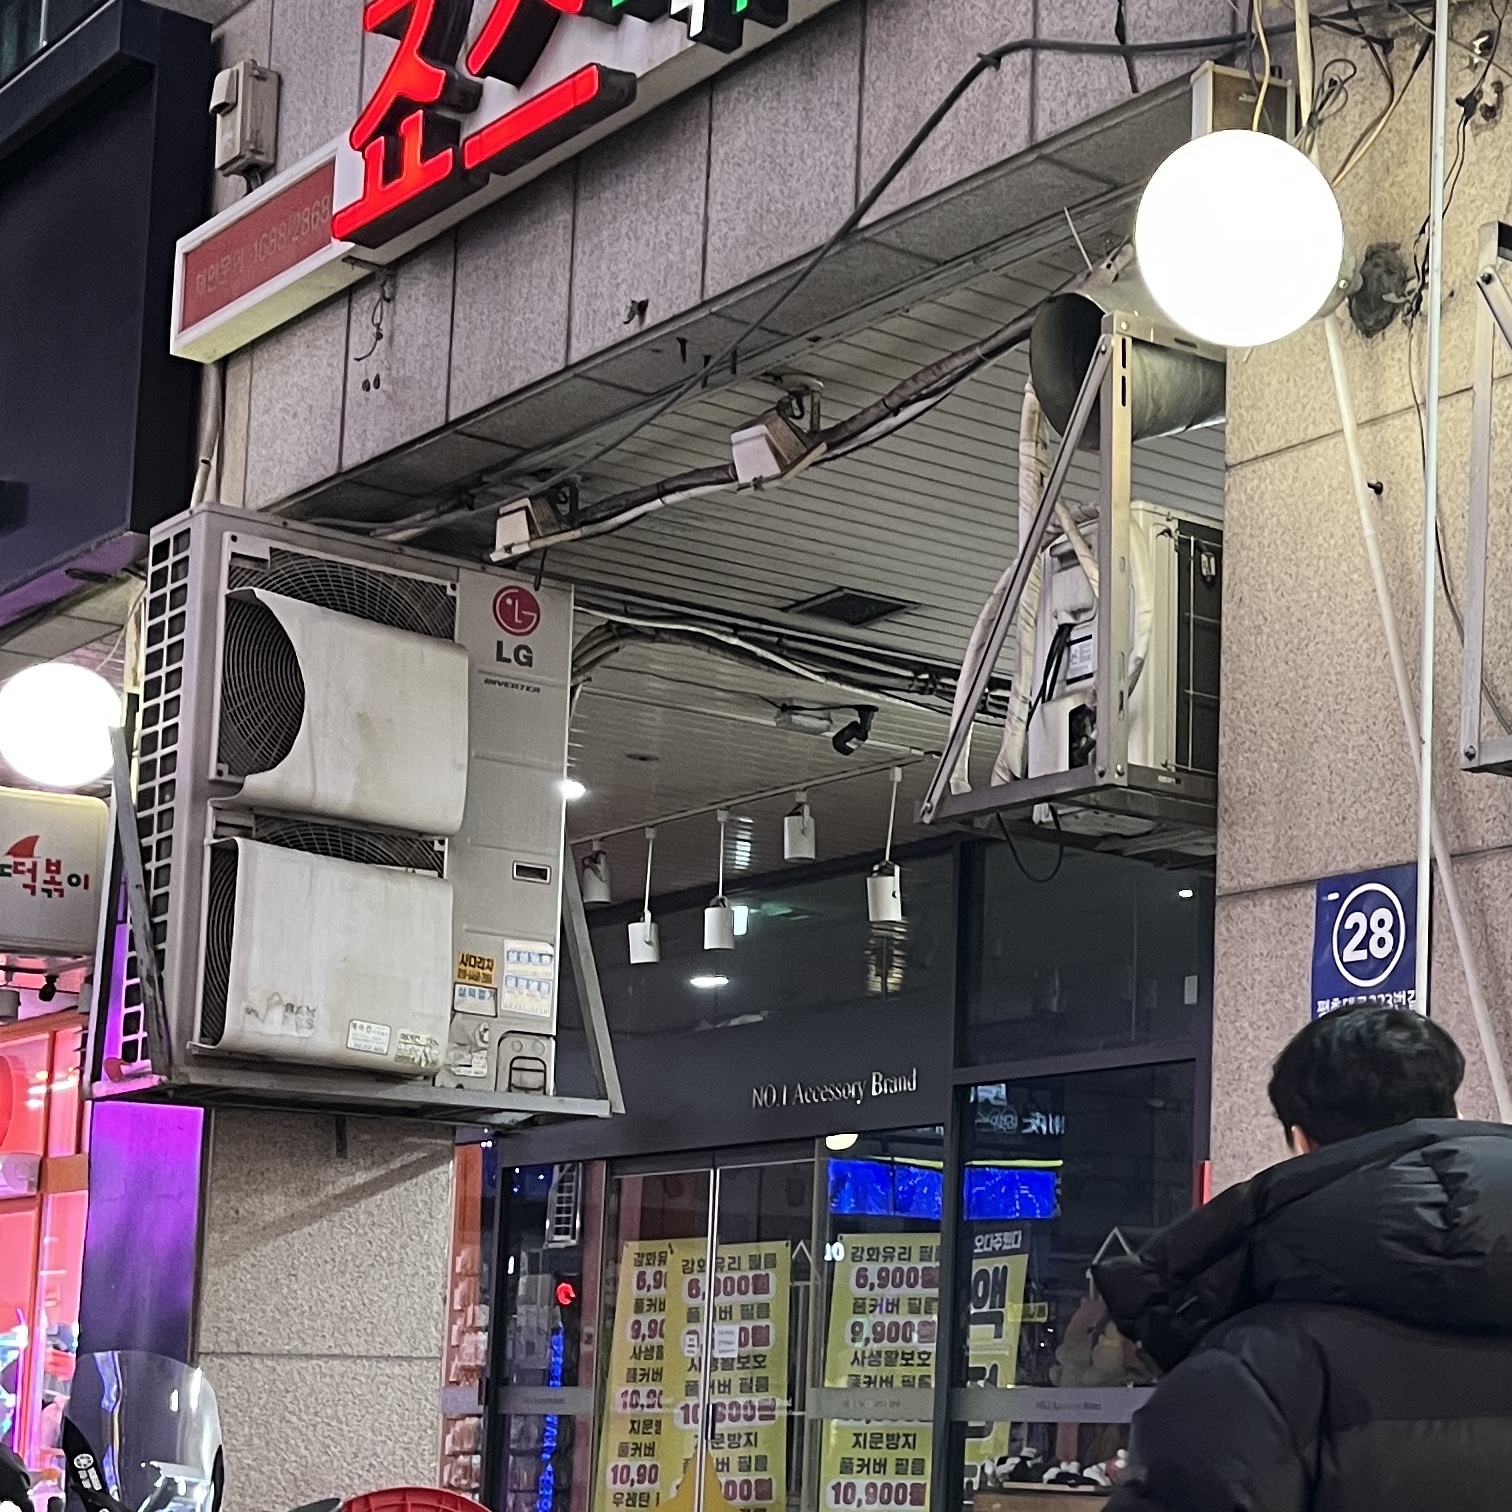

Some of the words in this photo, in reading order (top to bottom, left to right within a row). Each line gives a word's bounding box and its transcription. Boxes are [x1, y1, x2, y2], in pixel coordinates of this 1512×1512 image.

[496, 640, 533, 668] LG
[1342, 907, 1394, 963] 28
[791, 1080, 867, 1105] Accessory
[871, 1067, 917, 1097] Brand
[851, 1245, 912, 1263] 강화유리
[850, 1350, 932, 1368] 사생활보호
[852, 1432, 917, 1450] 지문방지
[831, 1481, 927, 1508] 10,900원
